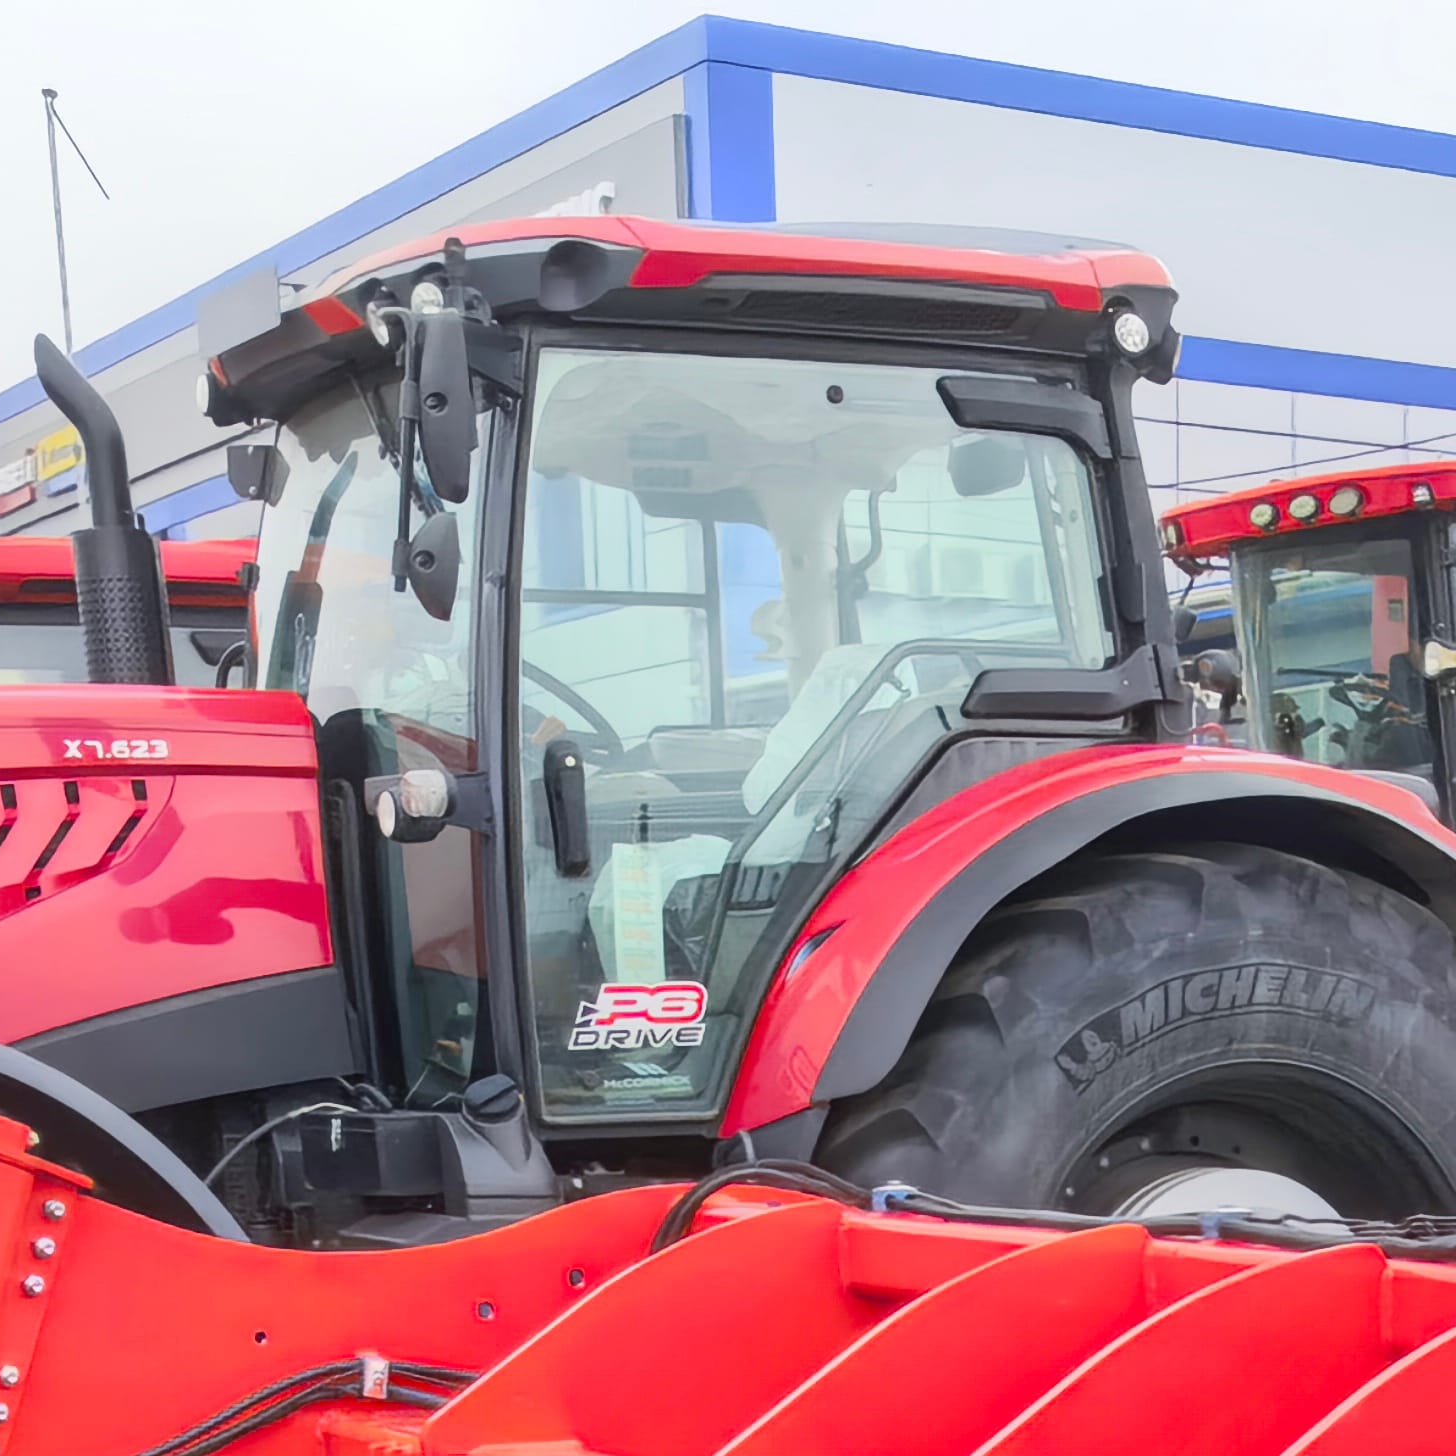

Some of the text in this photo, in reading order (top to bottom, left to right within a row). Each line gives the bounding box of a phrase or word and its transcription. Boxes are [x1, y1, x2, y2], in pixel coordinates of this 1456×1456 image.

[63, 739, 169, 759] X7.623
[1120, 964, 1376, 1044] MICHELIN
[571, 1026, 703, 1047] DRIVE
